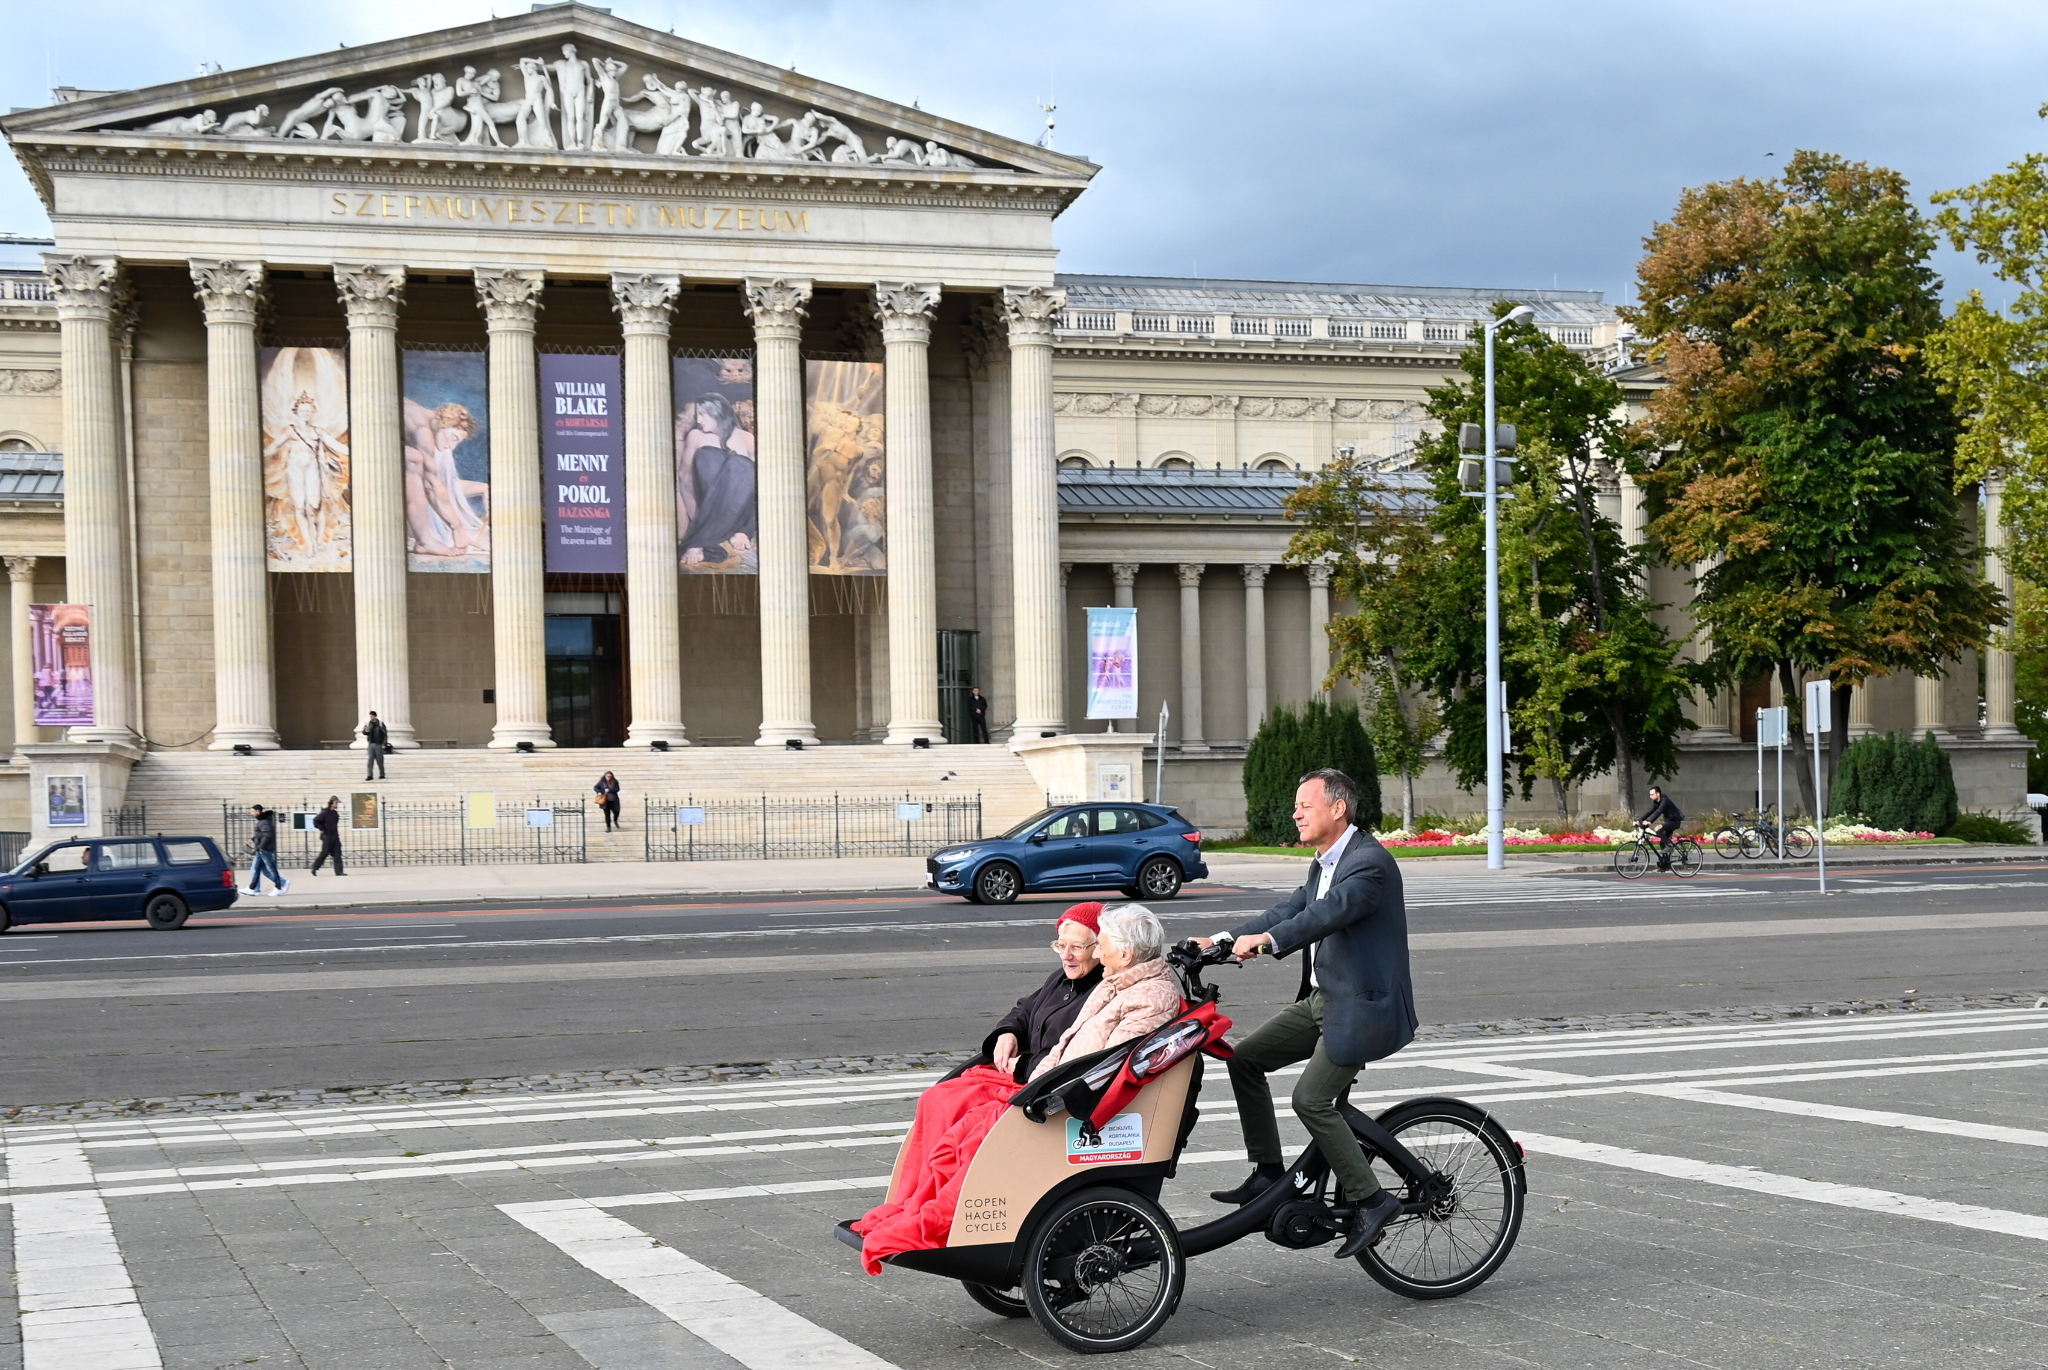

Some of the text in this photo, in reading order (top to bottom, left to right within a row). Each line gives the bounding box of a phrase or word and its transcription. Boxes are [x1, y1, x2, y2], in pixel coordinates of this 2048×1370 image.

[554, 381, 606, 397] WILLIAM
[555, 396, 608, 416] BLAKE
[556, 453, 609, 472] MENNY
[557, 484, 611, 504] POKOL
[558, 504, 612, 519] HÁZASSÁGA
[560, 524, 612, 536] The Marriage of
[560, 536, 612, 545] Heaven and Hell
[1079, 1152, 1131, 1162] MAGYARORSZÁG
[964, 1197, 1006, 1209] COPEN
[965, 1209, 1007, 1221] HAGEN
[965, 1221, 1007, 1233] CYCLES
